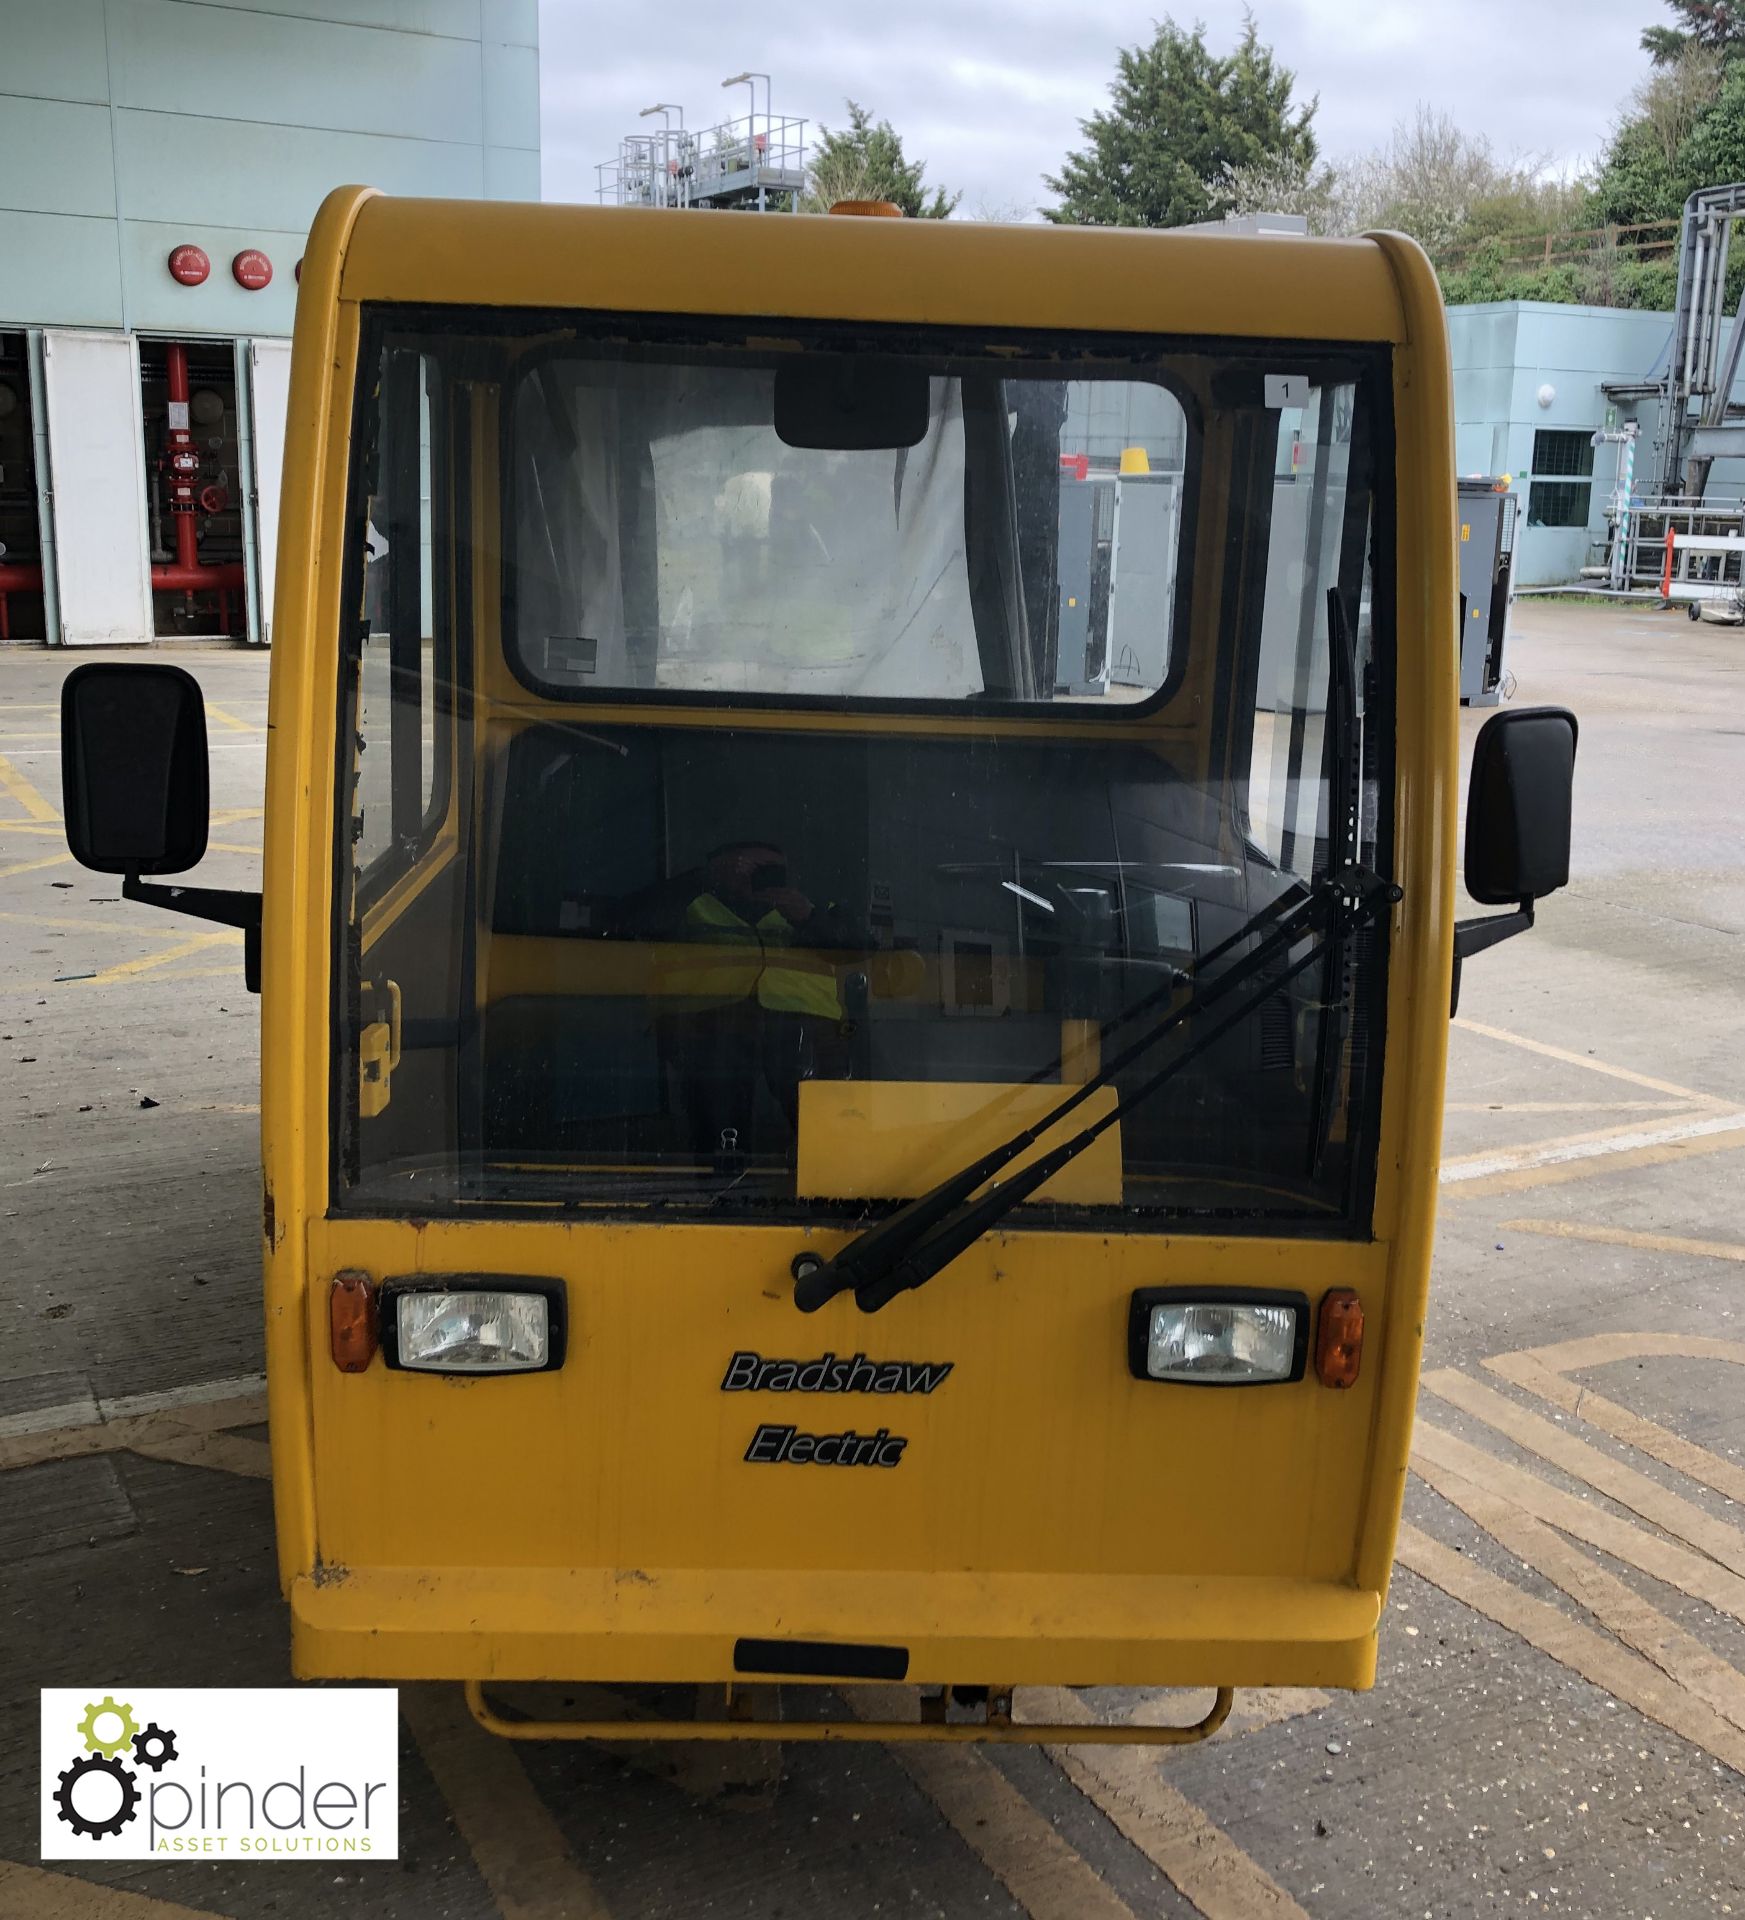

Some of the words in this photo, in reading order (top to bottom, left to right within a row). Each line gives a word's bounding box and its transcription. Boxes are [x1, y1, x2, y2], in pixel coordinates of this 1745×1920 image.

[1281, 382, 1289, 399] 1
[722, 1352, 954, 1393] Bradshaw
[745, 1424, 907, 1467] Electric
